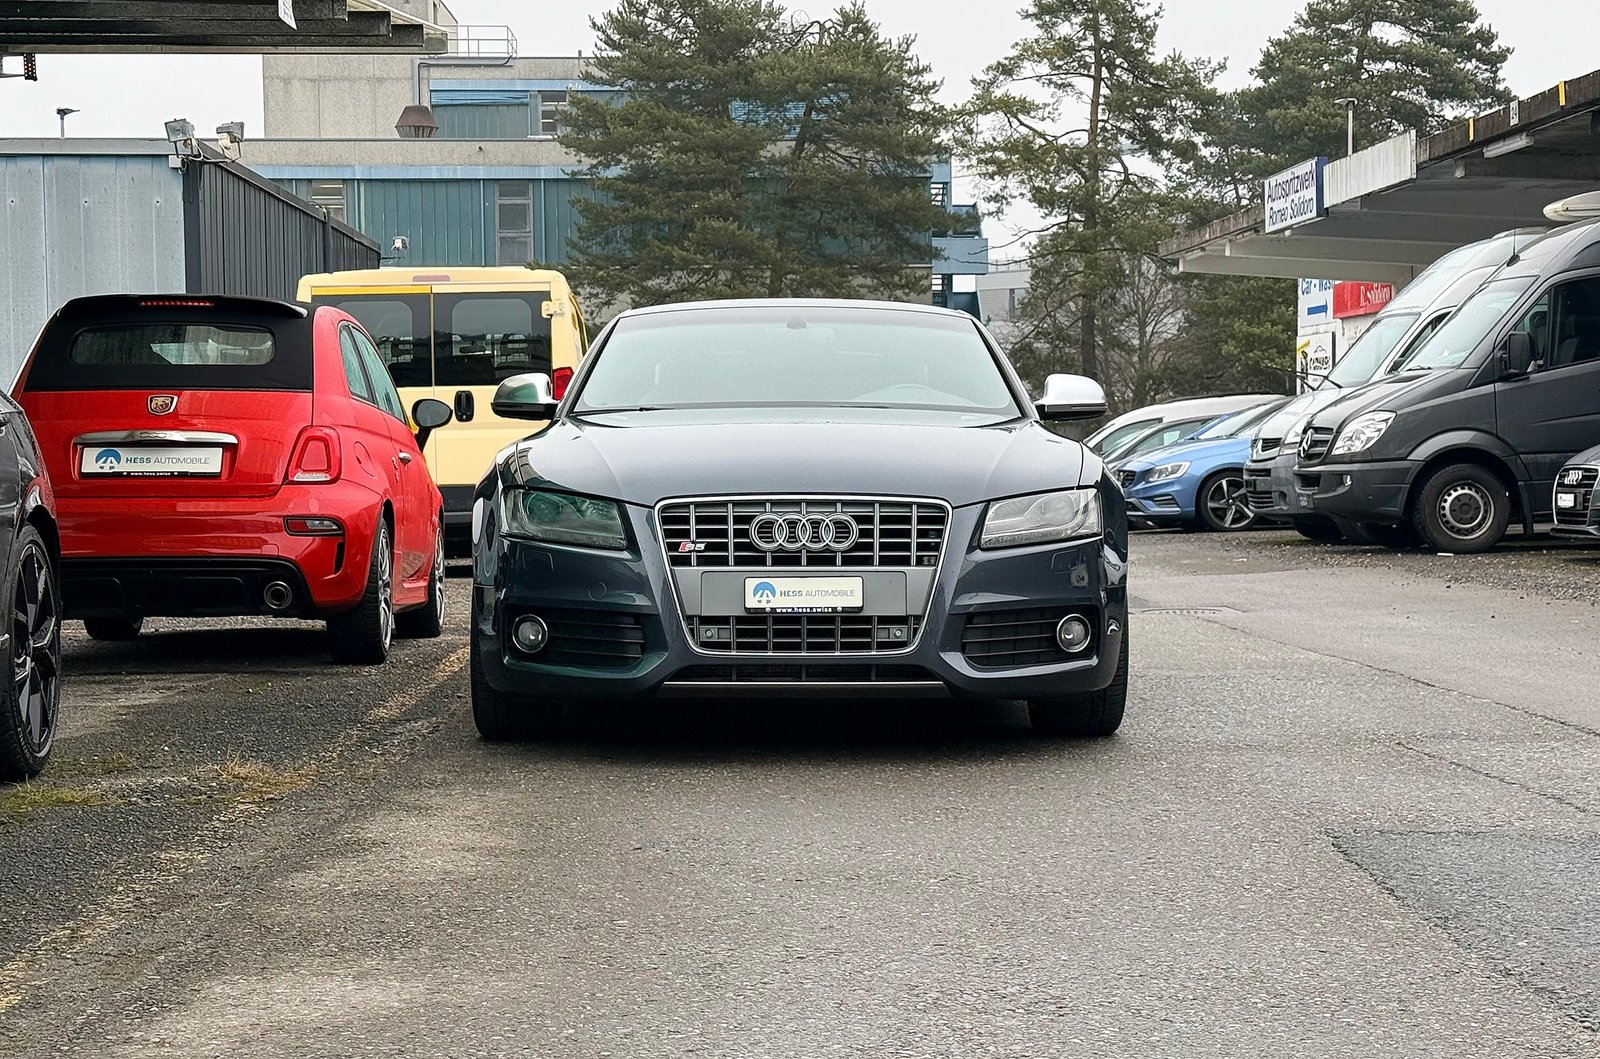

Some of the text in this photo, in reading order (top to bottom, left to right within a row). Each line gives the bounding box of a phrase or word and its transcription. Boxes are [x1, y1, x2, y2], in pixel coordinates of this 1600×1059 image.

[1267, 162, 1315, 205] Autospritzwerk
[1269, 195, 1313, 227] Romeo Solidoro
[1301, 279, 1312, 295] Car
[153, 457, 210, 465] AUTOMOBILE
[685, 543, 706, 551] S5
[805, 589, 855, 597] AUTOMOBILE
